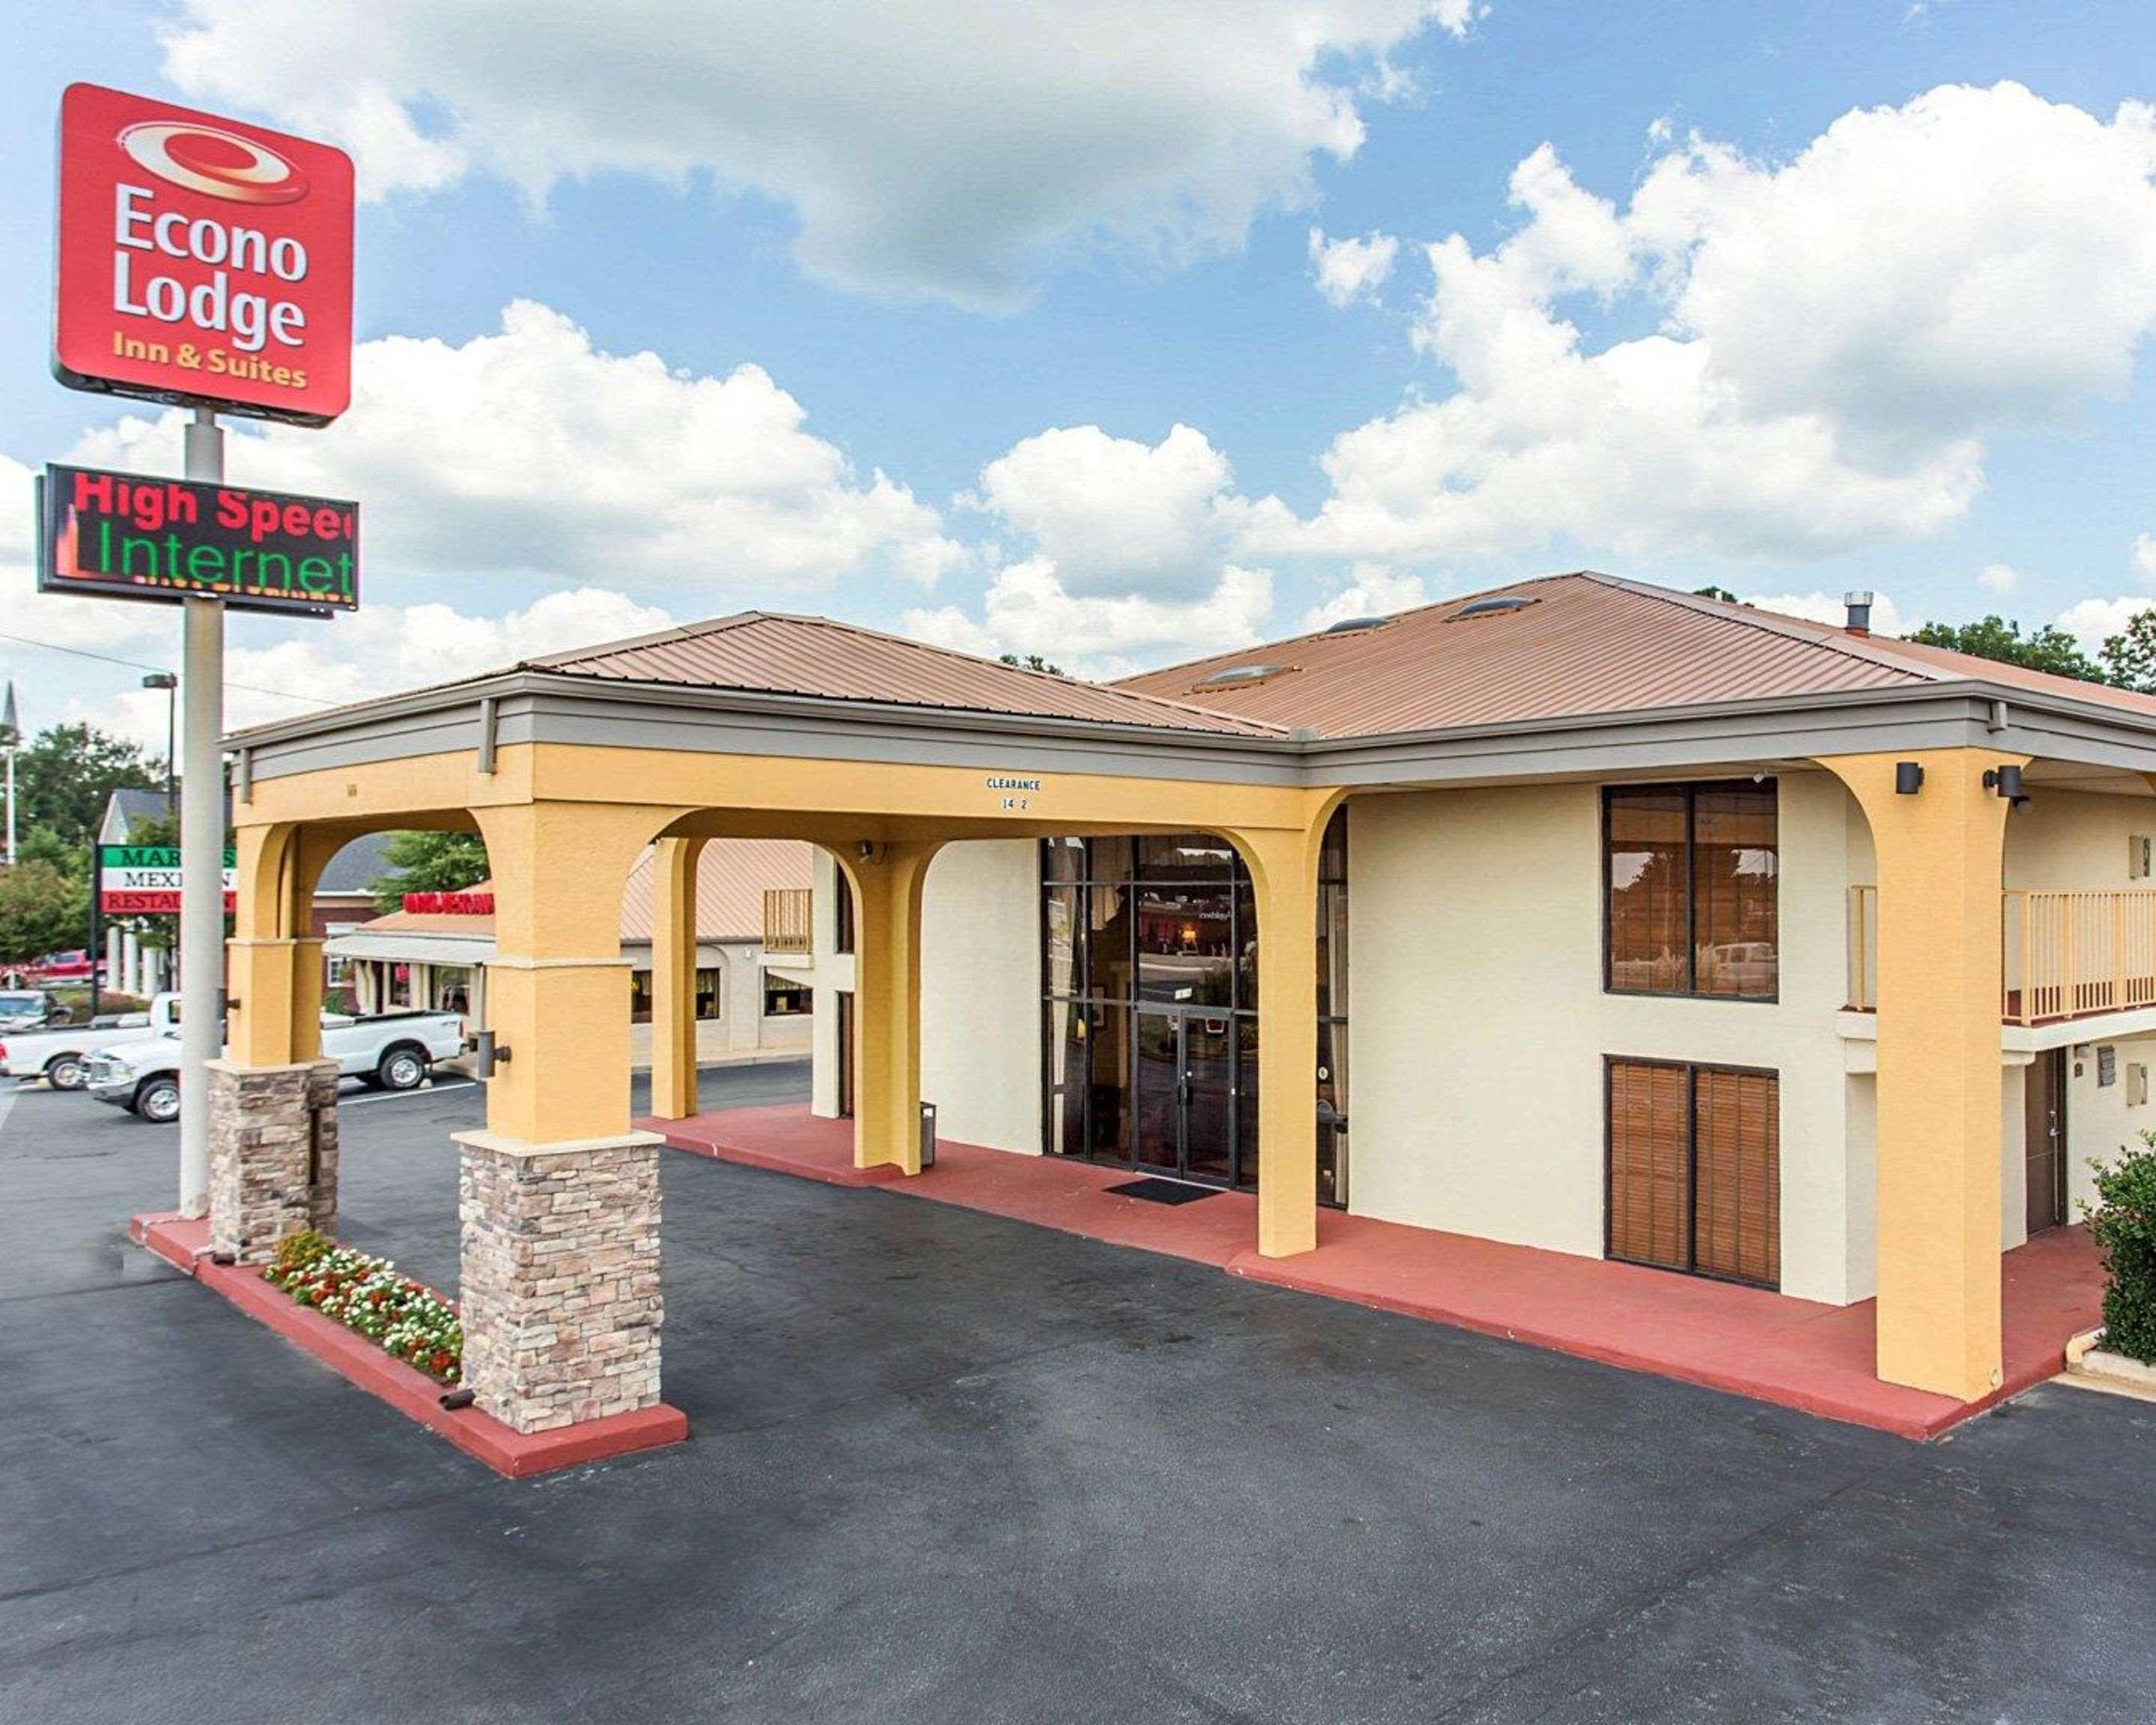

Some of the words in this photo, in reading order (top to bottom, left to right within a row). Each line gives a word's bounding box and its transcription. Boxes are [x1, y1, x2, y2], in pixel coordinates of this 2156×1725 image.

[114, 182, 308, 282] Econo
[113, 251, 306, 352] Lodge
[113, 331, 169, 364] Inn
[175, 343, 201, 371] &
[207, 349, 307, 389] Suites
[75, 472, 198, 531] High
[100, 519, 353, 596] Internet
[986, 778, 1041, 791] CLEARANCE
